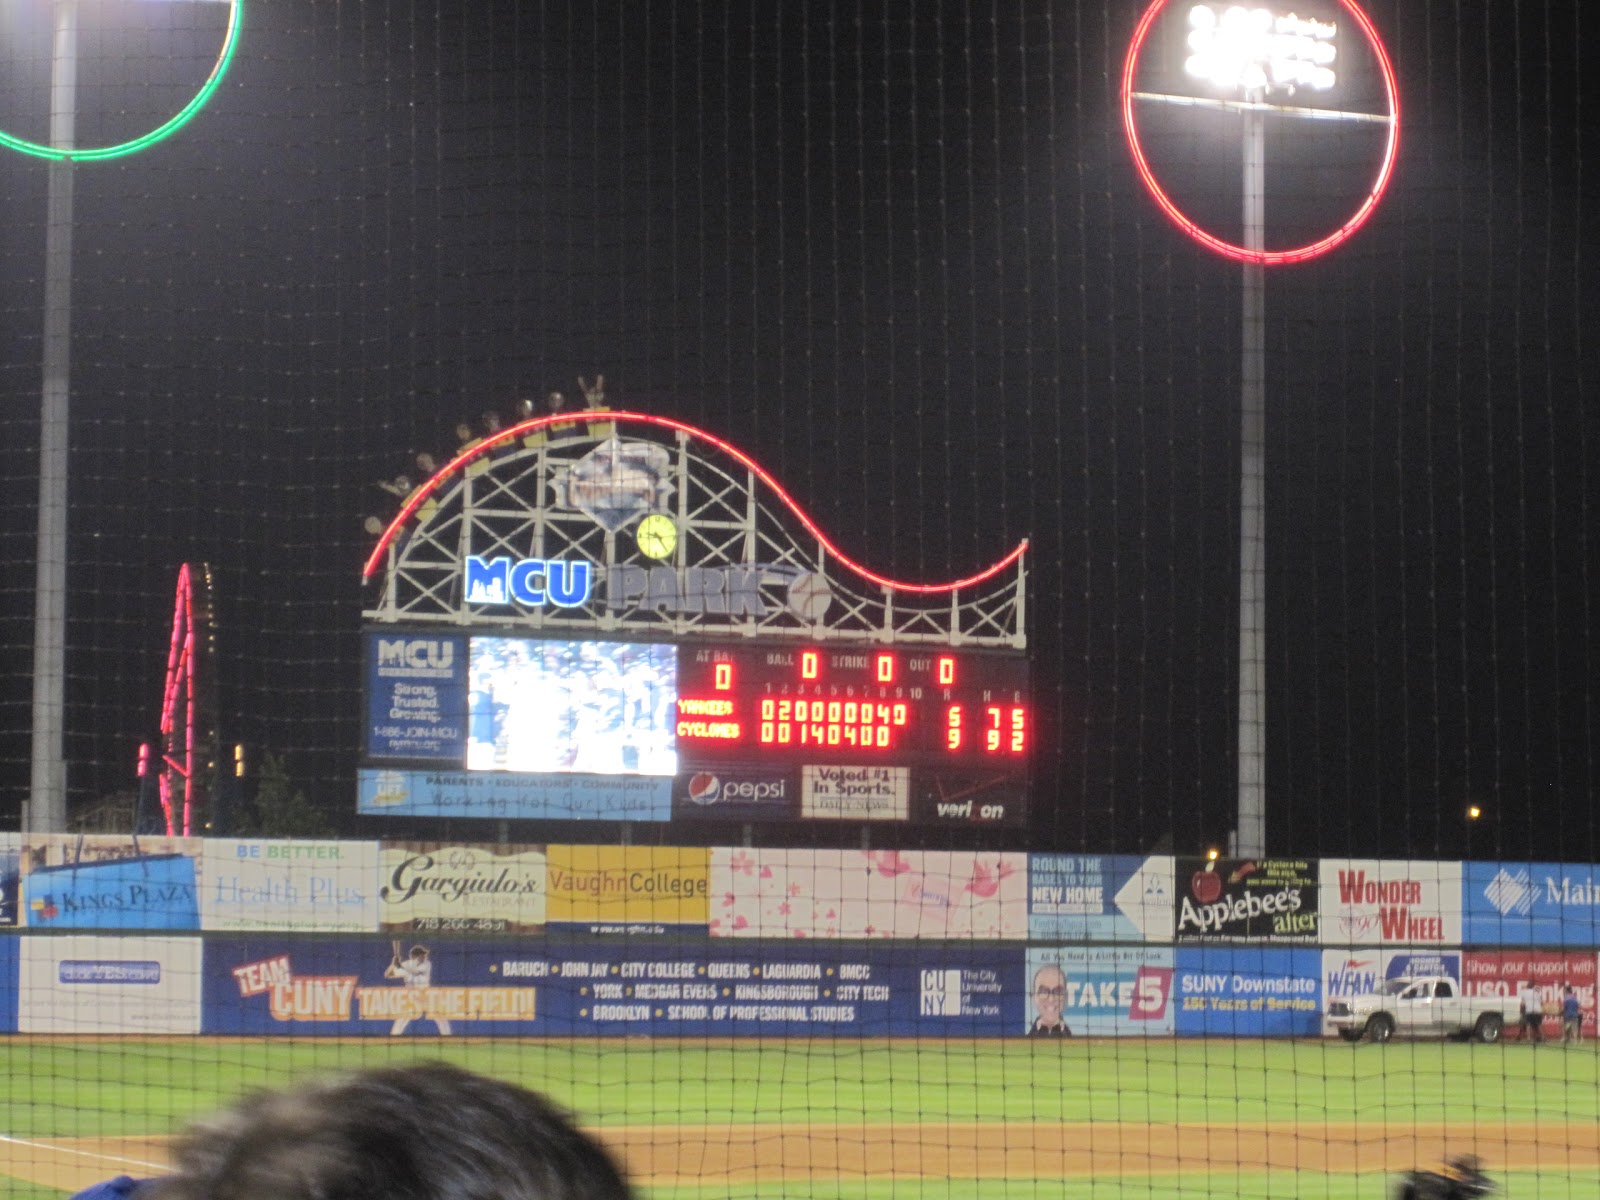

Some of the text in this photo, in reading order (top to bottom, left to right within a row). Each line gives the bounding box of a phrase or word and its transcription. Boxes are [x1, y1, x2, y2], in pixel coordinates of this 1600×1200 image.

[465, 555, 769, 616] MCU PARK
[378, 640, 454, 668] MCU
[696, 651, 710, 662] AT
[767, 653, 795, 666] BALL
[803, 653, 817, 678] 0
[878, 656, 892, 681] 0
[910, 659, 931, 671] OUT
[940, 659, 953, 684] 0
[716, 664, 731, 690] 0
[677, 700, 733, 716] YANKEES
[988, 708, 1000, 728] 7
[1012, 709, 1024, 729] 5
[677, 721, 740, 739] CYCLONES
[949, 728, 960, 748] 9
[988, 730, 999, 750] 9
[1012, 730, 1024, 751] 2
[425, 776, 659, 790] PARENTS EDUCATORS COMMUNITY
[819, 768, 890, 782] Voted #1
[723, 780, 785, 801] pepsi
[814, 781, 896, 796] In Sports.
[432, 791, 507, 814] Working
[236, 845, 345, 859] BE BETTER.
[1032, 857, 1102, 873] ROUND THE
[380, 855, 537, 904] Gargiulo's
[1032, 874, 1103, 886] BASES TO YOUR
[1338, 869, 1421, 905] WONDER
[214, 876, 298, 903] Health
[1032, 886, 1104, 904] NEW HOME
[62, 885, 192, 914] KINGS PLAZA
[1178, 880, 1301, 932] Applebee's
[416, 919, 439, 930] 718
[1380, 906, 1445, 941] WHEEL
[1067, 951, 1085, 960] Need
[234, 957, 291, 994] TEAM
[502, 961, 871, 980] BARUCH JOHN JAY CITY COLLEGE QUEENS LAGUARDIA BMCC
[963, 970, 997, 982] The City
[1467, 960, 1595, 976] Show your support with
[962, 982, 1003, 993] University
[1182, 975, 1316, 994] SUNY Downstate
[1328, 960, 1376, 997] WFAN
[272, 979, 353, 1015] CUNY
[359, 989, 424, 1013] TAKES
[426, 989, 465, 1014] THE
[593, 983, 889, 1001] YORK MEDGAR EVERS KINGSBOROUGH CITY TECH
[962, 994, 971, 1003] of
[1066, 976, 1164, 1013] TAKE 5
[593, 1005, 855, 1022] BROOKLYN SCHOOL OF PROFESSIONAL STUDIES
[962, 1005, 999, 1015] New York
[1210, 997, 1248, 1011] Years
[1251, 997, 1265, 1011] of
[1267, 997, 1316, 1011] Service
